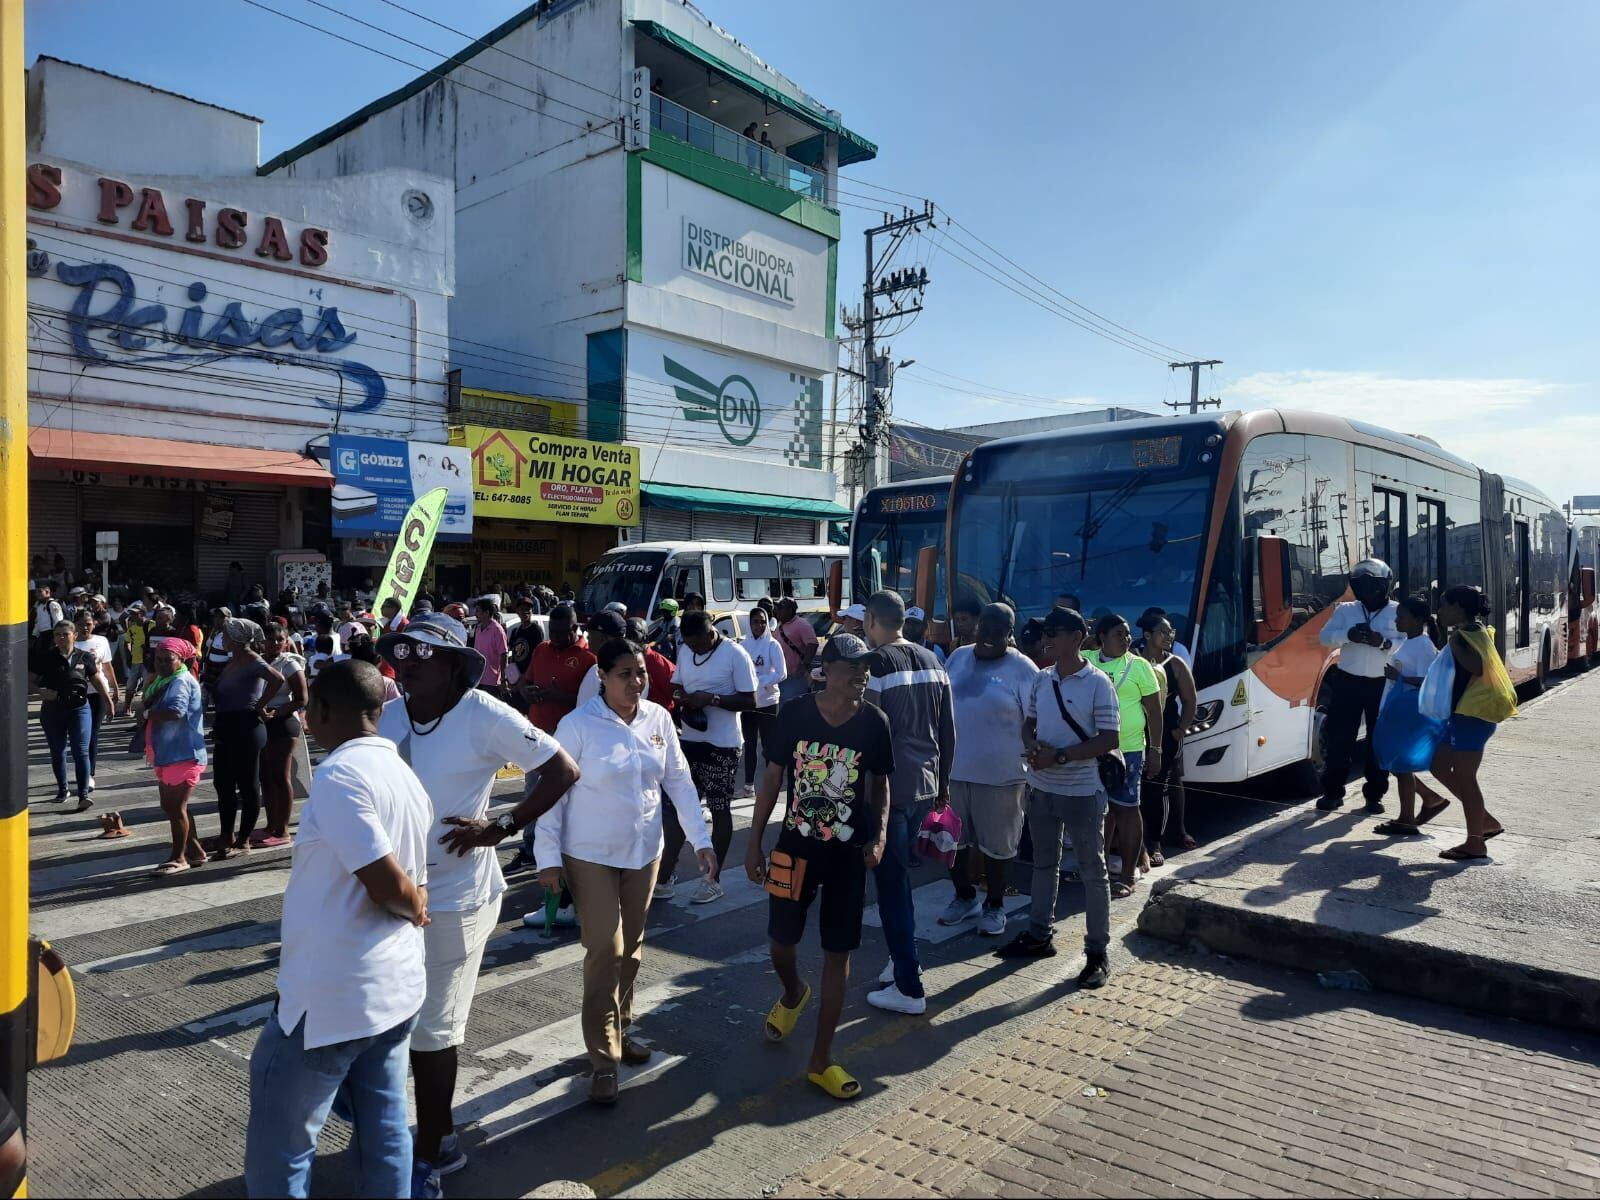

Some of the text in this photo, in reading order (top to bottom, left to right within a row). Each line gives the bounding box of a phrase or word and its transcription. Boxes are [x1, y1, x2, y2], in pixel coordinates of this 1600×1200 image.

[633, 72, 642, 146] HOTEL
[97, 177, 329, 267] PAISAS
[687, 222, 795, 277] DISTRIBUIDORA
[687, 241, 794, 302] NACIONAL
[56, 261, 357, 368] Paisas
[722, 395, 754, 426] DN
[528, 437, 631, 464] Compra Venta
[528, 460, 632, 487] MI HOGAR
[491, 493, 532, 504] 647-8085
[570, 486, 593, 494] PLATA
[620, 501, 629, 512] 24
